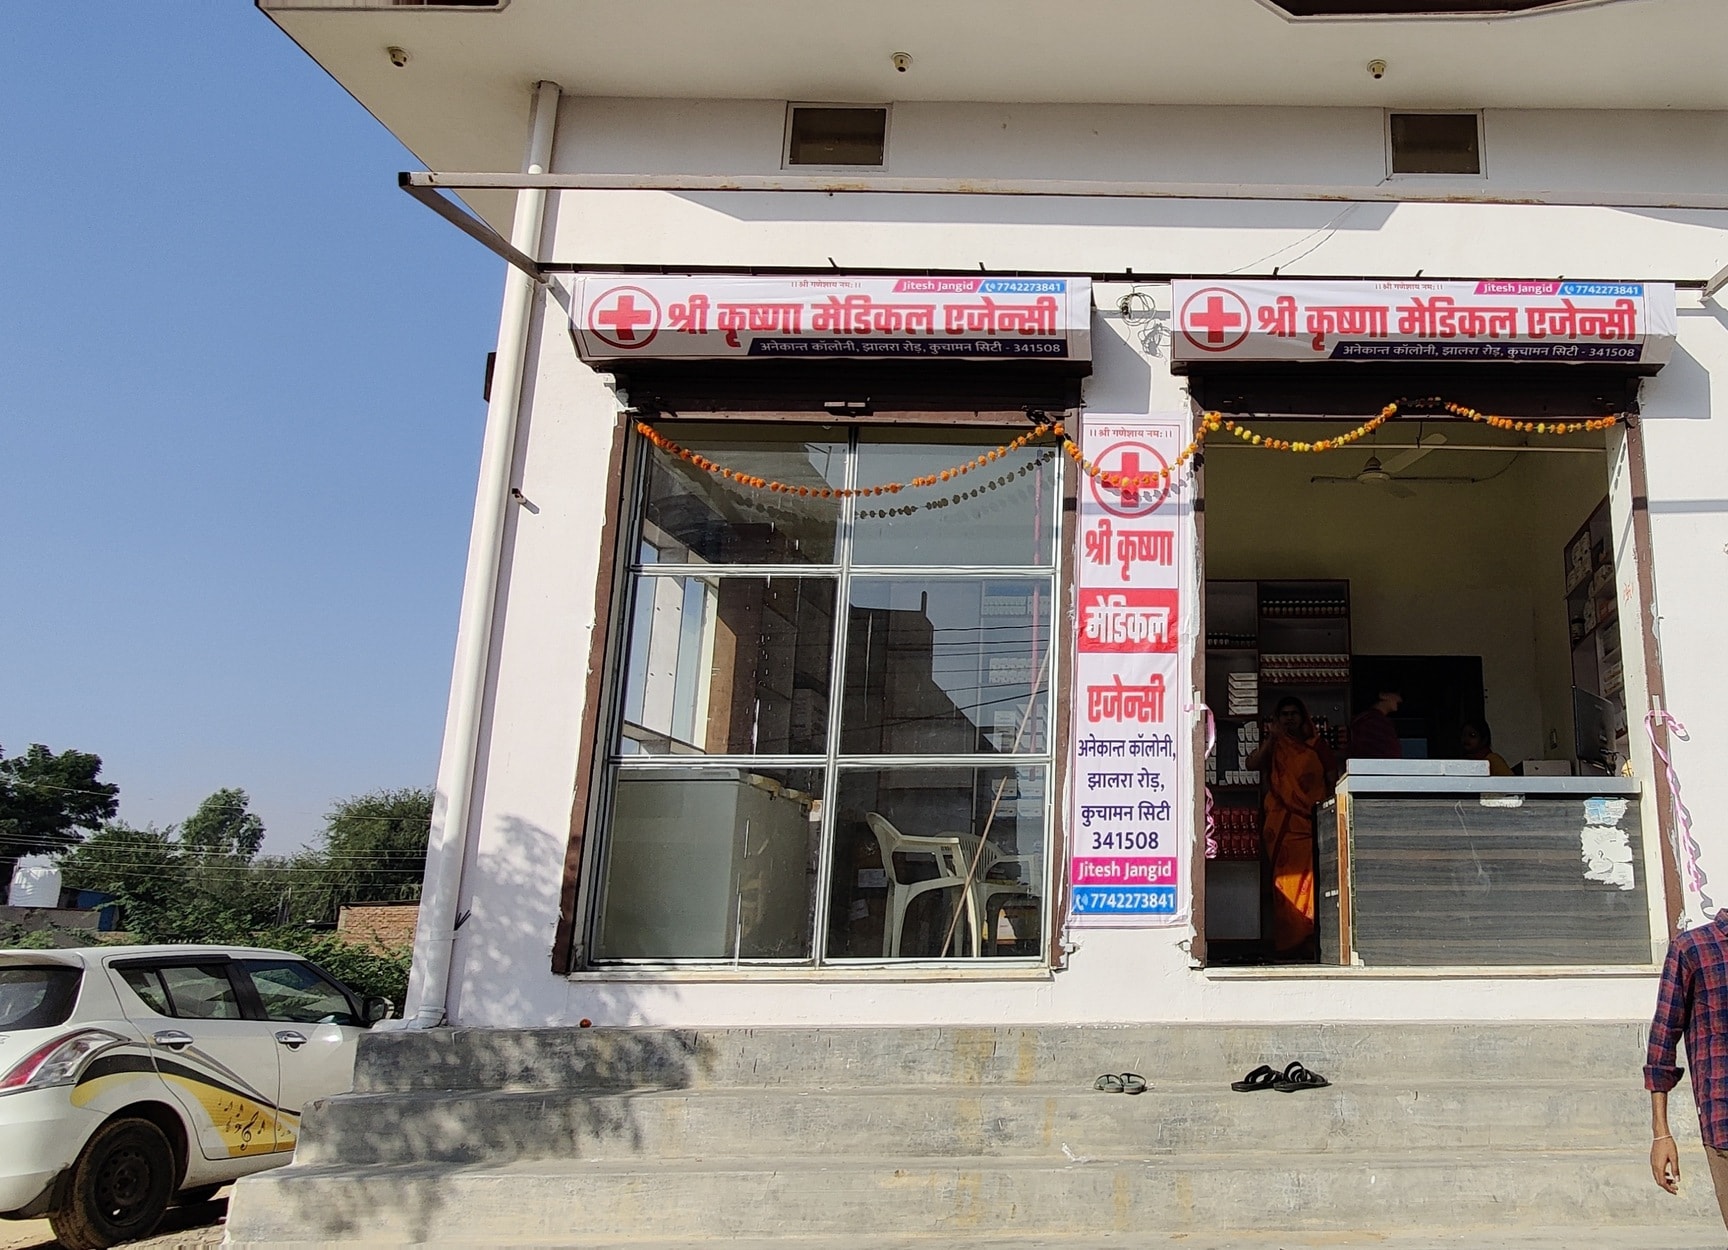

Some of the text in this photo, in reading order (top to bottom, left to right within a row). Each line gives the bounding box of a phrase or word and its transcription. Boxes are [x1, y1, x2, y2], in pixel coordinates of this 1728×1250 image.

[902, 281, 973, 292] Jitesh Jangid
[997, 282, 1061, 292] 7742273841
[1483, 283, 1553, 295] Jitesh Jangid
[1575, 285, 1638, 295] 7742273841
[668, 294, 1058, 347] श्री कृष्णा मेडिकल एजेन्सी
[1257, 296, 1637, 351] श्री कृष्णा मेडिकल एजेन्सी
[760, 339, 808, 352] अनेकान्त
[863, 342, 900, 353] झालरा
[929, 342, 972, 355] कुचामन
[975, 340, 1002, 353] सिटी
[1014, 343, 1060, 352] 341508
[1343, 343, 1389, 355] अनेकान्त
[1442, 345, 1479, 356] झालरा
[1507, 347, 1549, 359] कुचामन
[1552, 345, 1578, 357] सिटी
[1589, 348, 1635, 357] 341508
[1113, 427, 1144, 438] गणेशाय
[1085, 518, 1174, 581] श्री कृष्णा
[1085, 594, 1170, 644] मेडिकल
[1087, 673, 1166, 723] एजेन्सी
[1078, 733, 1176, 761] अनेकान्त कॉलोनी,
[1087, 767, 1165, 792] झालरा रोड़,
[1081, 800, 1171, 827] कुचामन सिटी
[1092, 831, 1159, 850] 341508
[1078, 861, 1171, 881] Jitesh Jangid
[1091, 893, 1174, 909] 7742273841
